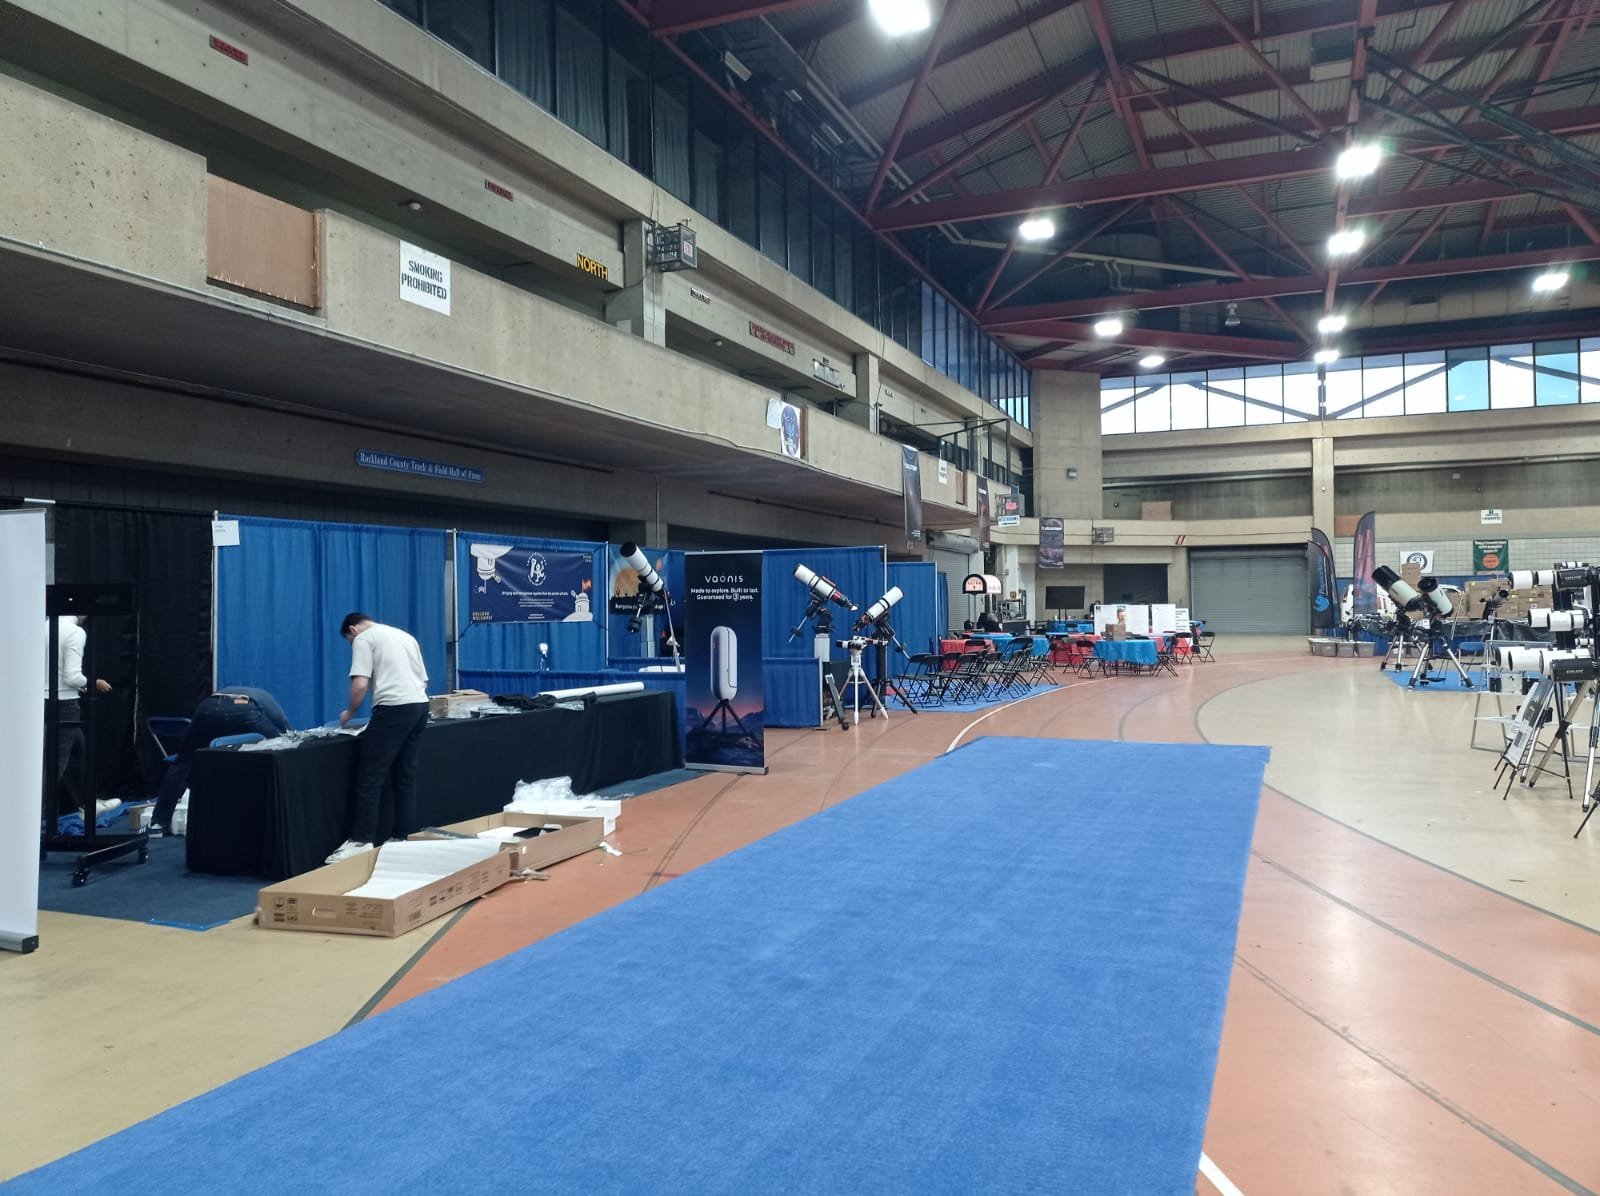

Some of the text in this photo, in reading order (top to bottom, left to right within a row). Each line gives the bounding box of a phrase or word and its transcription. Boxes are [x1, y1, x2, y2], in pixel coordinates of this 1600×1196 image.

[408, 260, 443, 283] SMOKING
[576, 253, 608, 281] NORTH
[401, 272, 447, 300] PROHIBITED
[360, 452, 388, 466] Rockland
[390, 458, 410, 470] County
[410, 461, 426, 472] Track
[434, 465, 448, 475] Field
[448, 467, 460, 477] Hall
[468, 470, 481, 480] Fame
